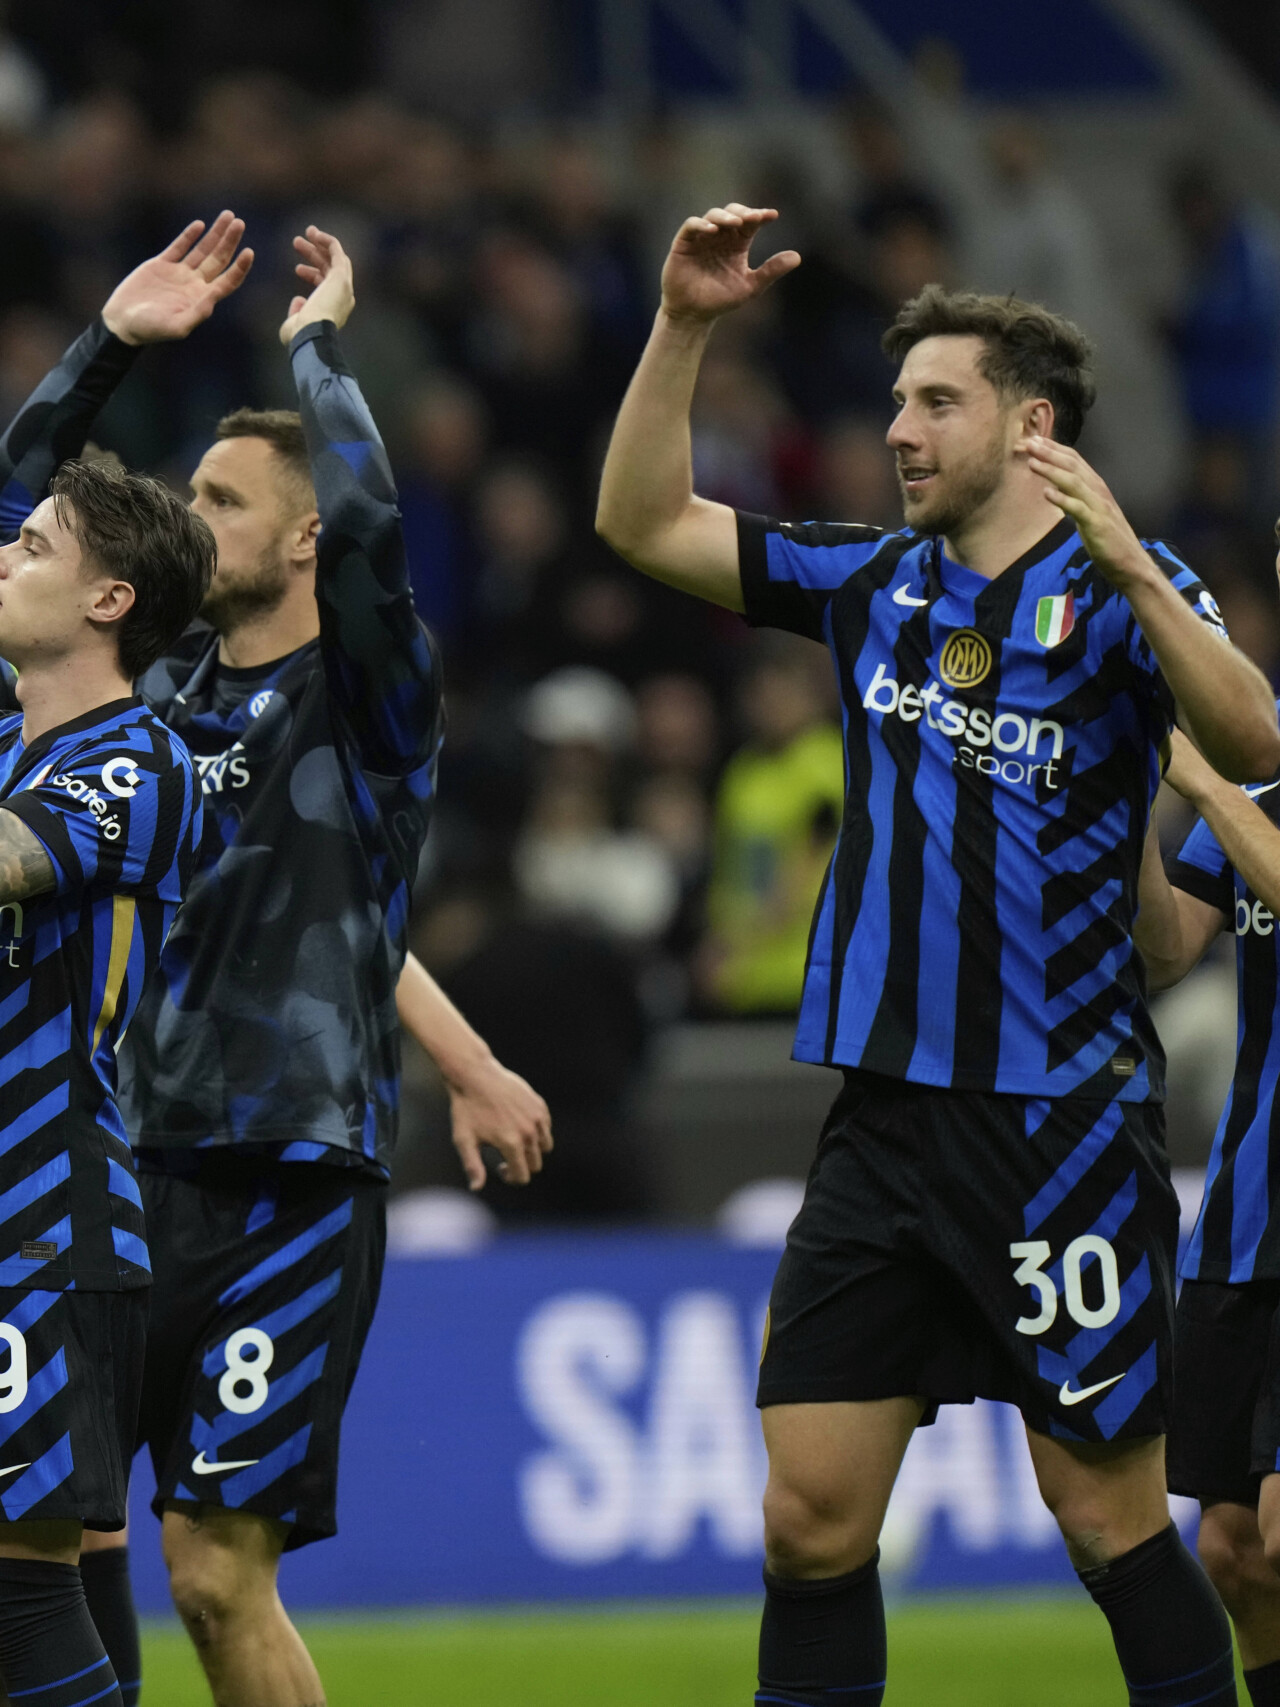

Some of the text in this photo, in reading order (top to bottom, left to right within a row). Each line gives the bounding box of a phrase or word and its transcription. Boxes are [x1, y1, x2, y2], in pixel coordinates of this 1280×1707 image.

[863, 663, 1064, 760] betsson
[53, 772, 121, 840] Gate.io
[953, 746, 1058, 789] .sport
[1234, 886, 1280, 936] be
[1009, 1234, 1121, 1336] 30
[218, 1327, 274, 1415] 8
